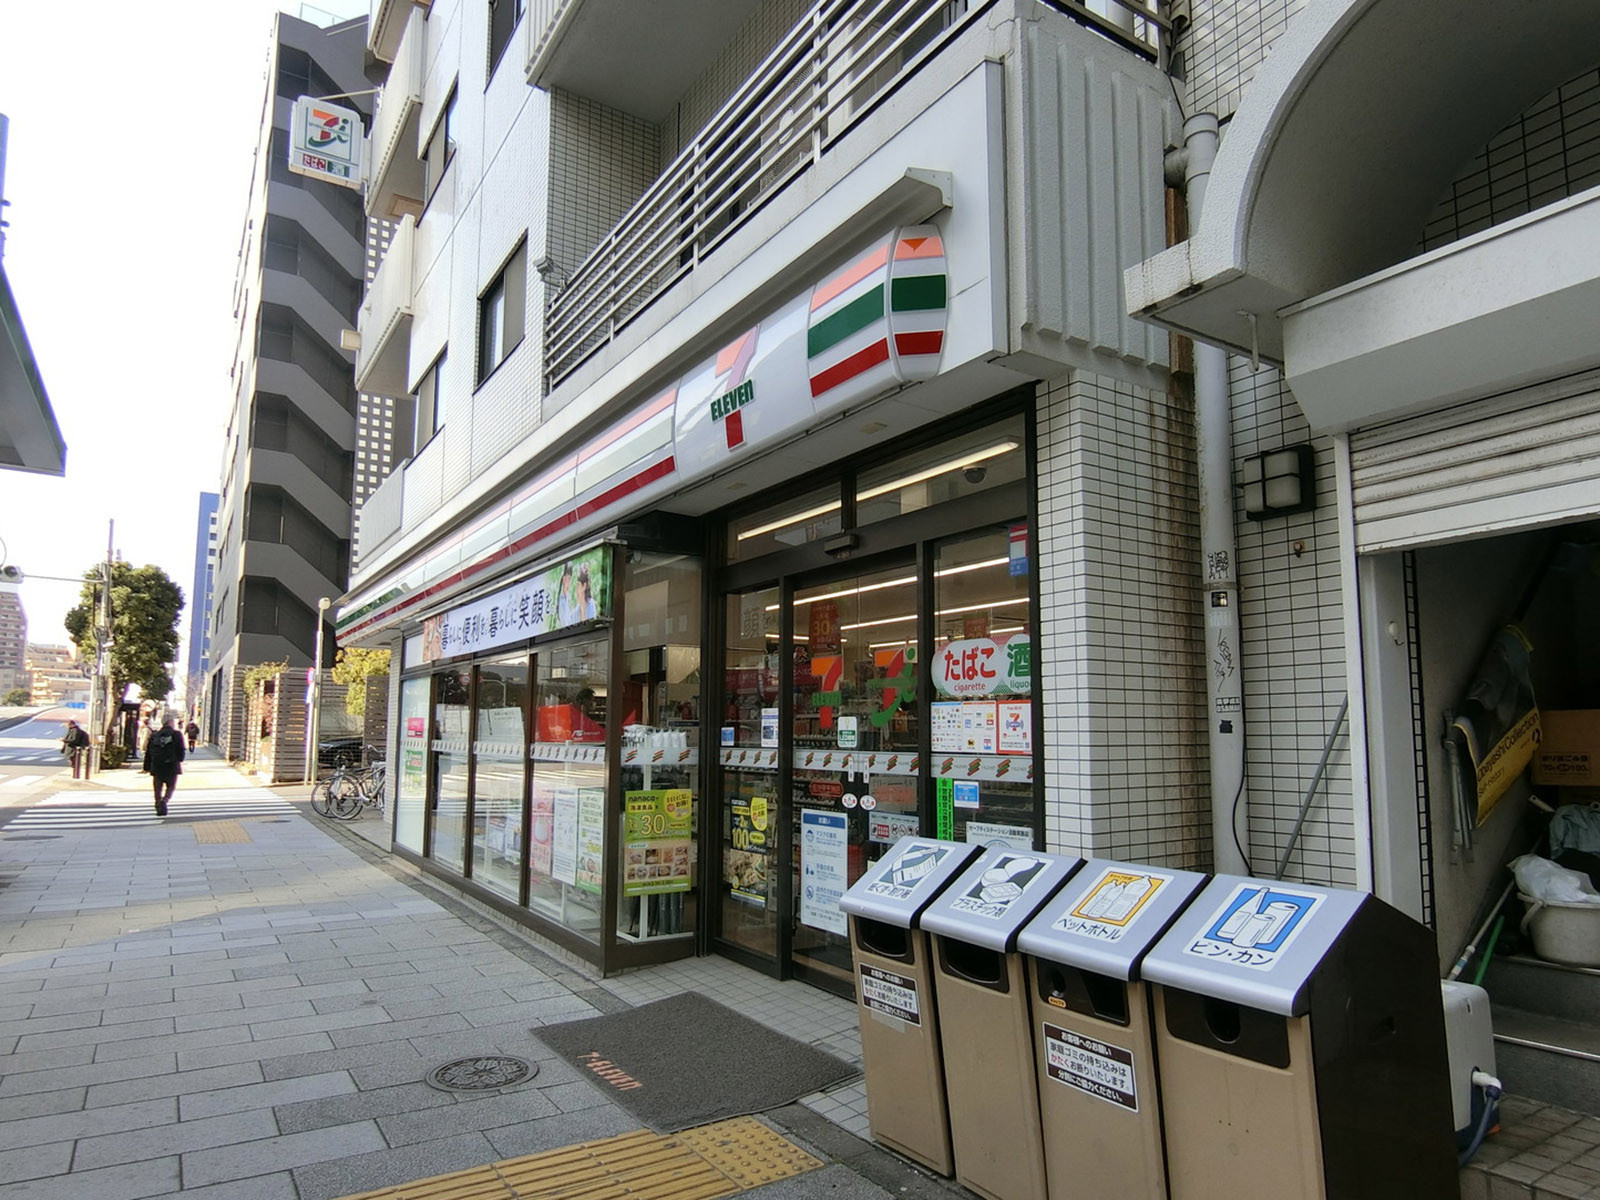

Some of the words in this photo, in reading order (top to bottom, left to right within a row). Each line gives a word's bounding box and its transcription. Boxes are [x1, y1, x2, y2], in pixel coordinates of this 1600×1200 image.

[945, 646, 997, 681] たばこ
[1006, 642, 1031, 678] 酒
[953, 682, 987, 693] cigarette
[1010, 680, 1030, 689] liquo
[640, 813, 667, 836] 30
[732, 828, 749, 852] 100
[1057, 917, 1122, 941] ペットボトル
[1190, 940, 1274, 967] ビン・カン
[1050, 1042, 1126, 1077] 家庭ゴミの持ち込みは
